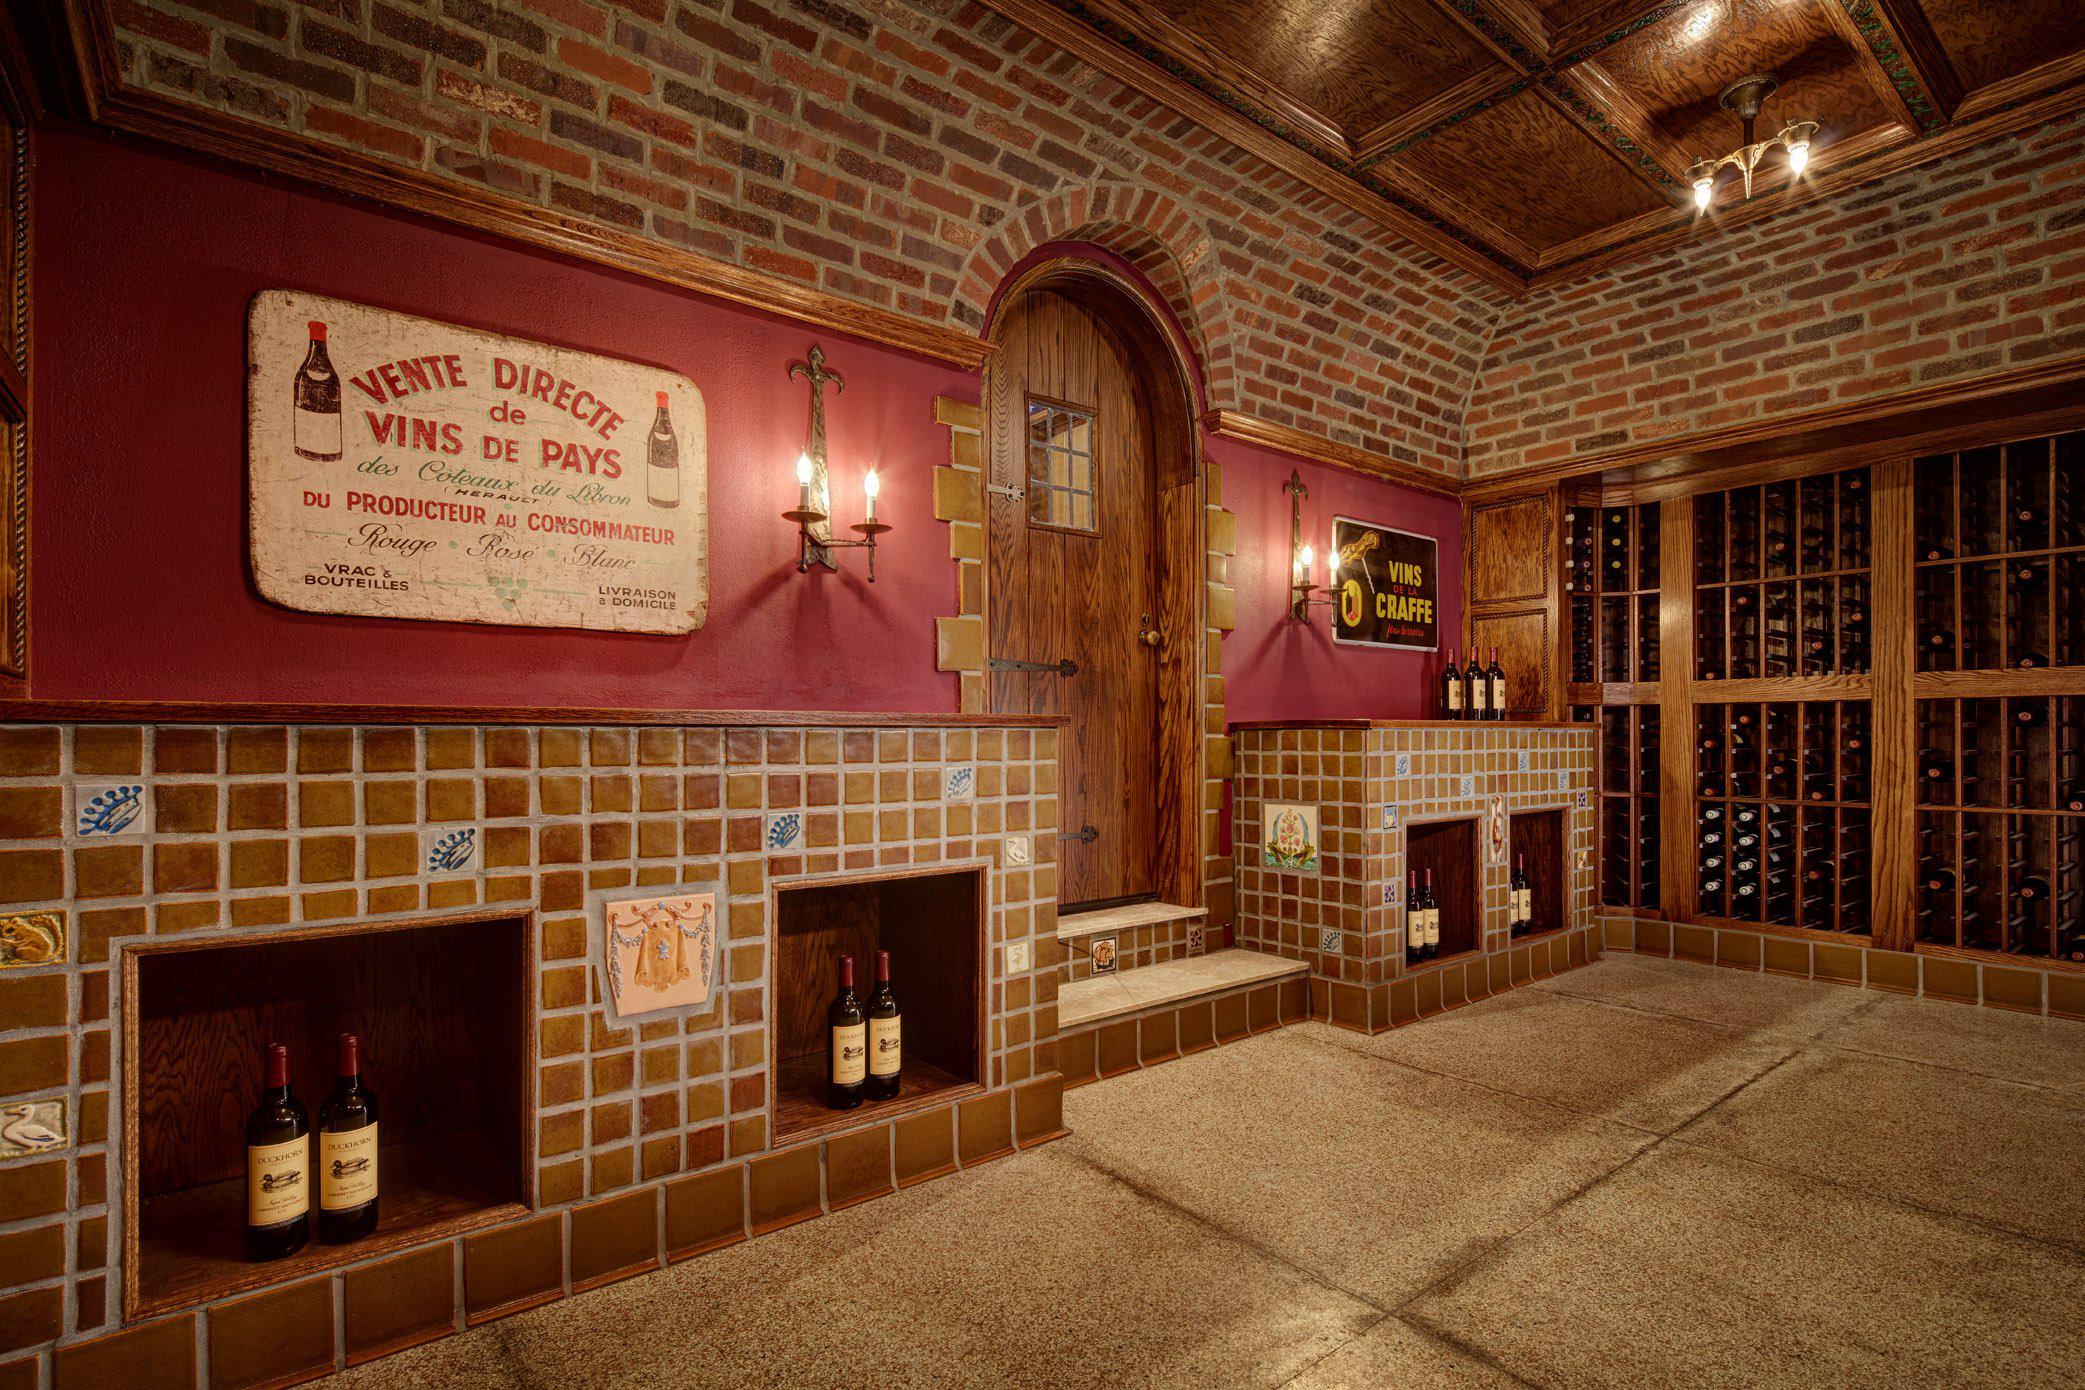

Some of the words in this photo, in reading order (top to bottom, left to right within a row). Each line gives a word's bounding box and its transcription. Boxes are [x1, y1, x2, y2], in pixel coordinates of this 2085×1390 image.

[349, 354, 467, 404] VENTE
[493, 357, 625, 441] DIRECTE
[489, 400, 526, 425] de
[365, 410, 463, 455] VINS
[483, 435, 518, 463] DE
[541, 438, 622, 479] PAYS
[357, 456, 400, 476] des
[531, 480, 561, 496] du
[566, 482, 631, 505] Libron
[303, 490, 331, 508] DU
[347, 491, 486, 526] PRODUCTEUR
[495, 513, 517, 528] AU
[528, 512, 675, 546] CONSOMMATEUR
[348, 522, 437, 558] Rouge
[563, 543, 636, 570] Blanc
[305, 574, 409, 591] BOUTEILLES
[324, 563, 376, 577] VRAC
[383, 569, 392, 579] &
[1389, 560, 1422, 587] VINS
[598, 585, 676, 600] LIVRAISON
[1393, 585, 1404, 594] DE
[1408, 587, 1417, 595] LA
[612, 597, 676, 610] DOMICILE
[1376, 592, 1432, 624] CRAFFE
[257, 1148, 303, 1164] DUCKHORN
[328, 1136, 372, 1151] DUCKHORN
